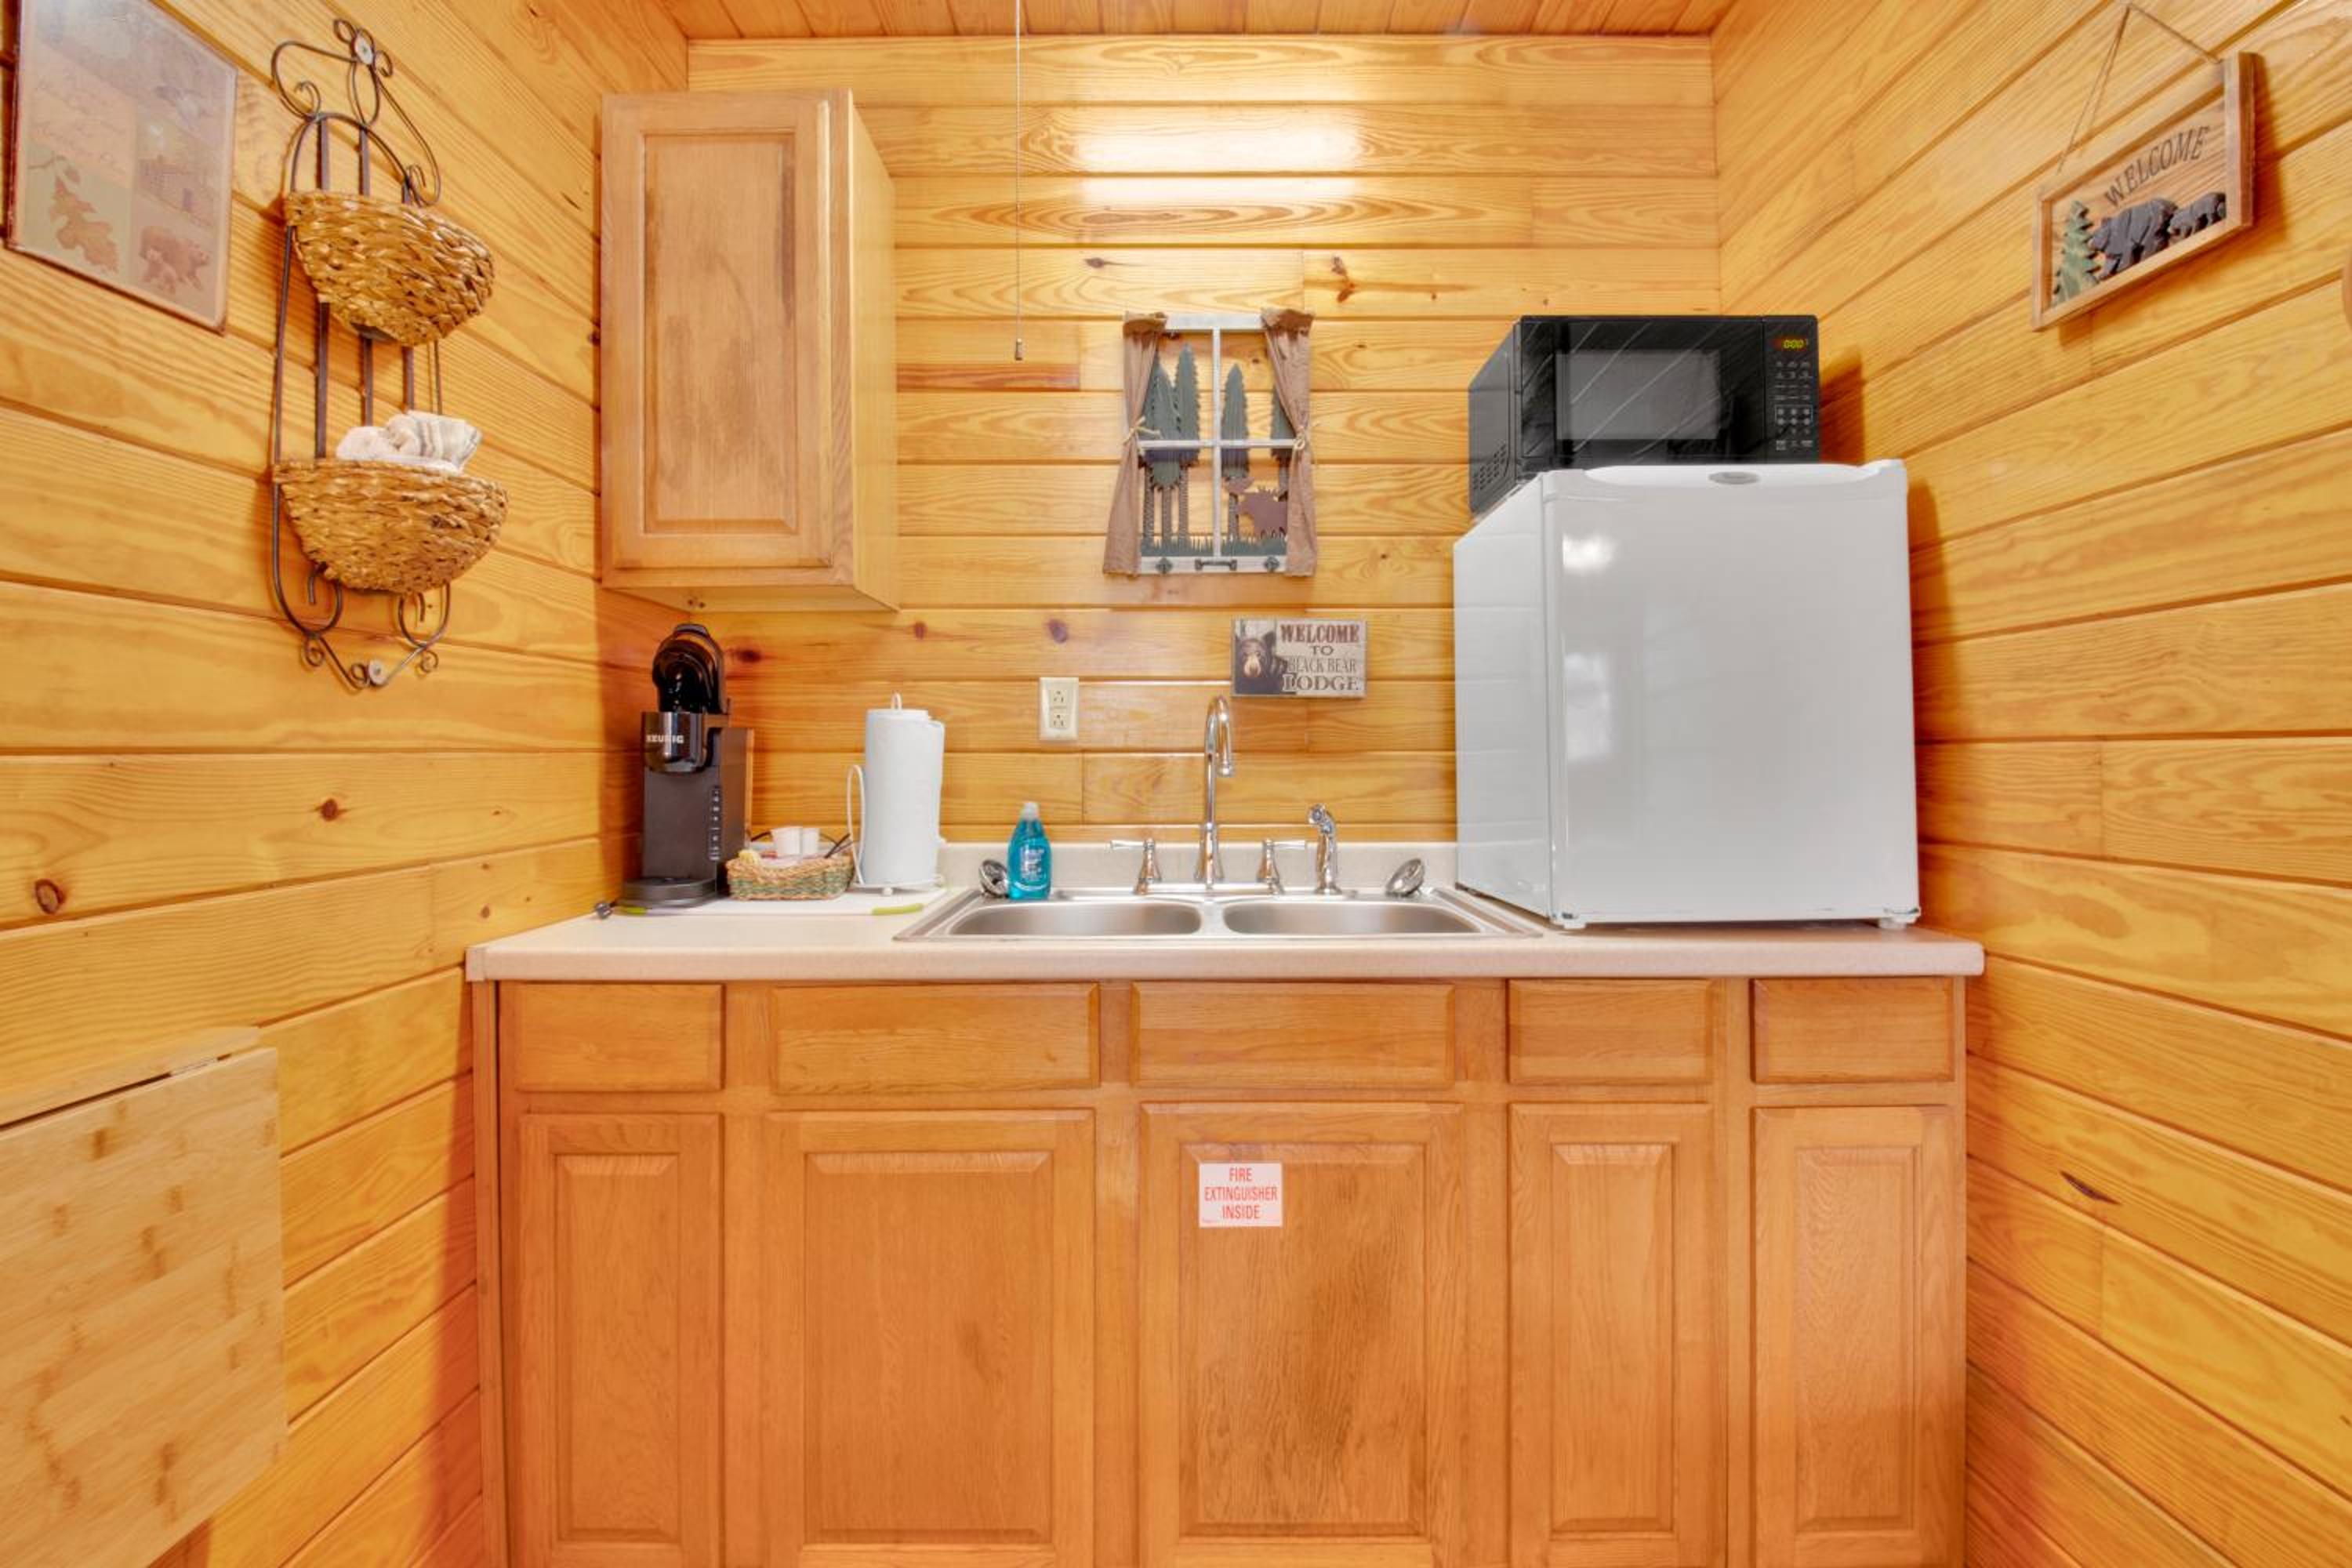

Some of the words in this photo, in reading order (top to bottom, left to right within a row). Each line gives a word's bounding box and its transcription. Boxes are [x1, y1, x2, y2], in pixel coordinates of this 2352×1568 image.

[2103, 125, 2211, 208] WELCOME
[1279, 624, 1360, 644] WELCOME
[1308, 645, 1335, 656] TO
[1288, 656, 1325, 673] BLACK
[1327, 658, 1357, 673] BEAR
[1282, 674, 1360, 691] LODGE
[1229, 1167, 1253, 1181] FIRE
[1203, 1185, 1278, 1202] EXTINGUISHER
[1221, 1204, 1261, 1219] INSIDE
